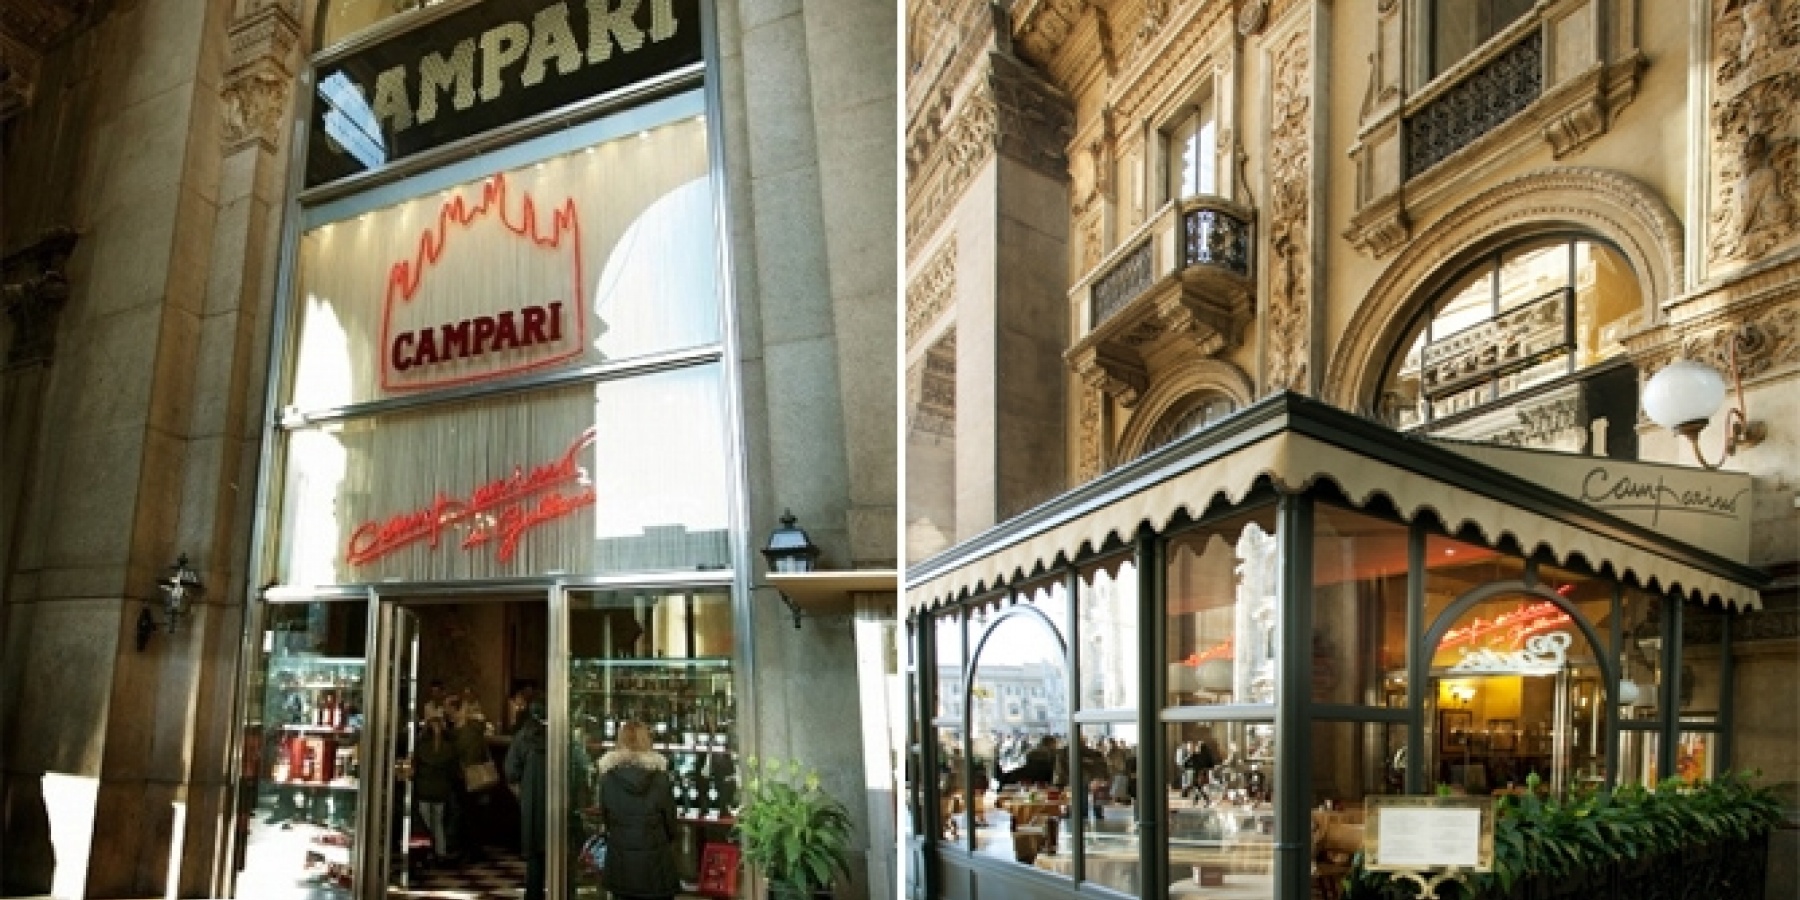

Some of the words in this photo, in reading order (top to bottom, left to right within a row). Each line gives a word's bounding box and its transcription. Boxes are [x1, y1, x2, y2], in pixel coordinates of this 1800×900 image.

[326, 0, 679, 152] AMPARI
[391, 302, 563, 371] CAMPARI
[1581, 466, 1749, 527] Camparino
